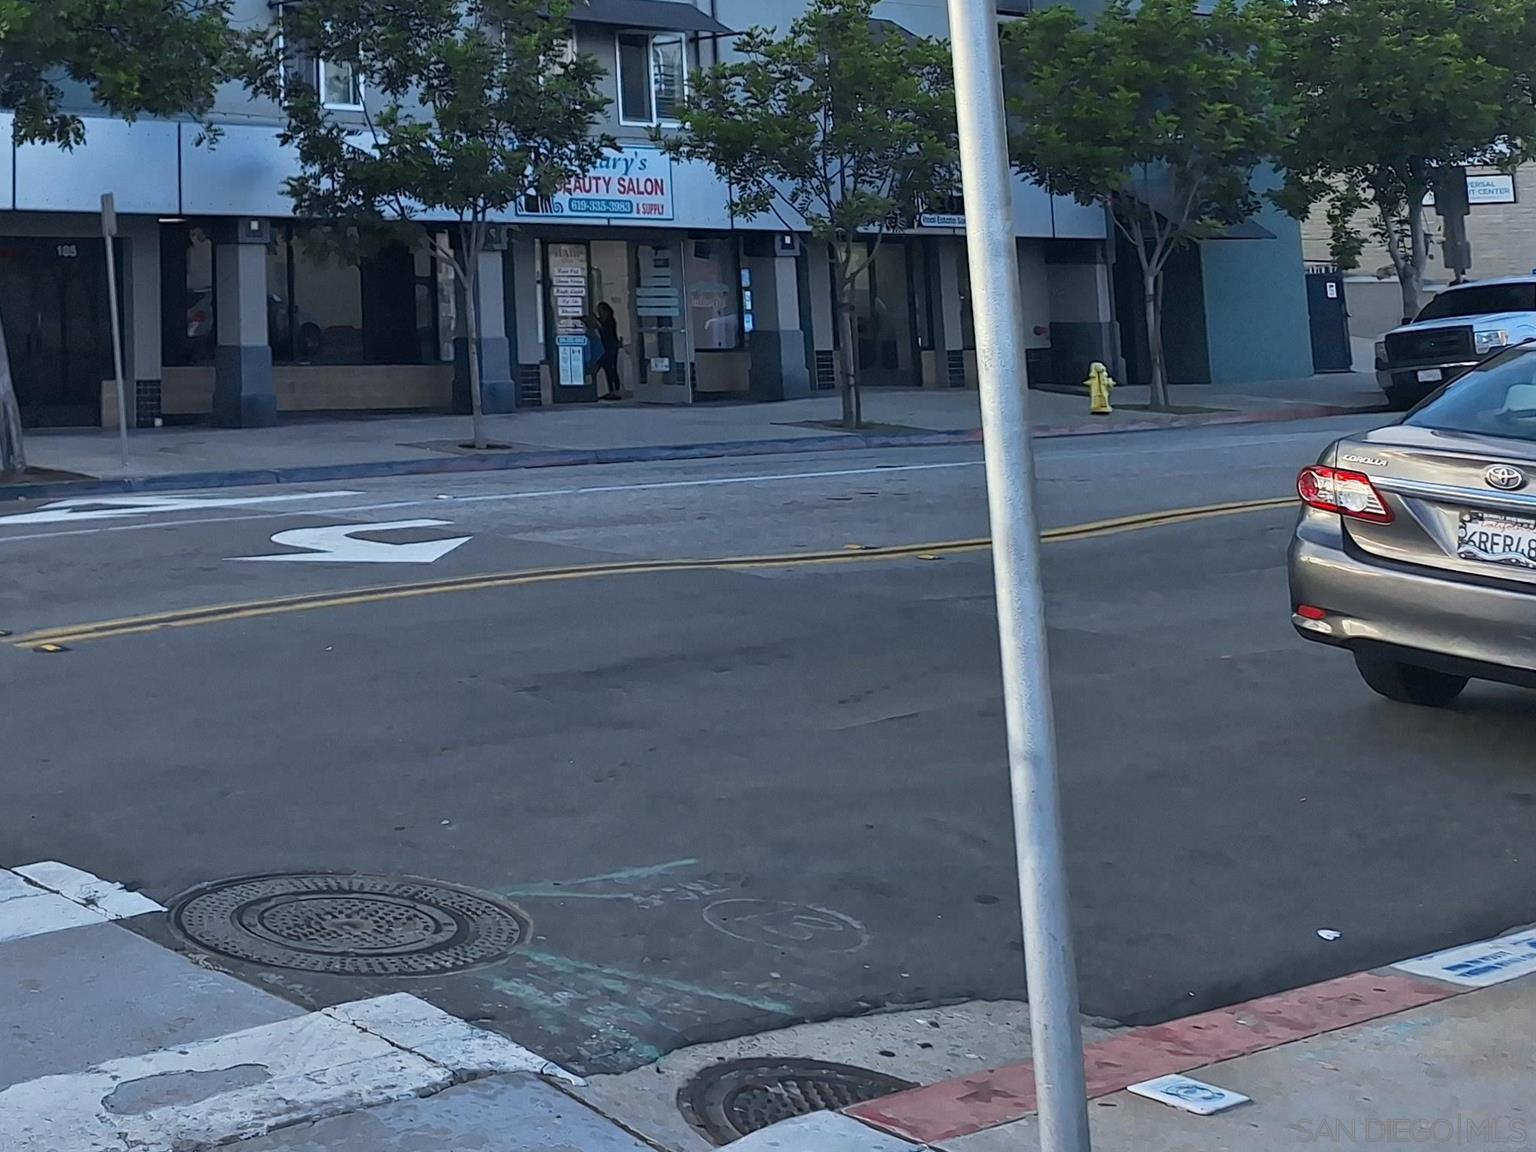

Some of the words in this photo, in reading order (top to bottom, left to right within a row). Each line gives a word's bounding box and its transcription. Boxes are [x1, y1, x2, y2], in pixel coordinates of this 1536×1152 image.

[592, 151, 648, 176] ary's
[617, 176, 665, 197] SALON
[1478, 188, 1511, 196] CENTER
[642, 203, 665, 216] SUPPLY
[1343, 454, 1389, 467] COROLLA
